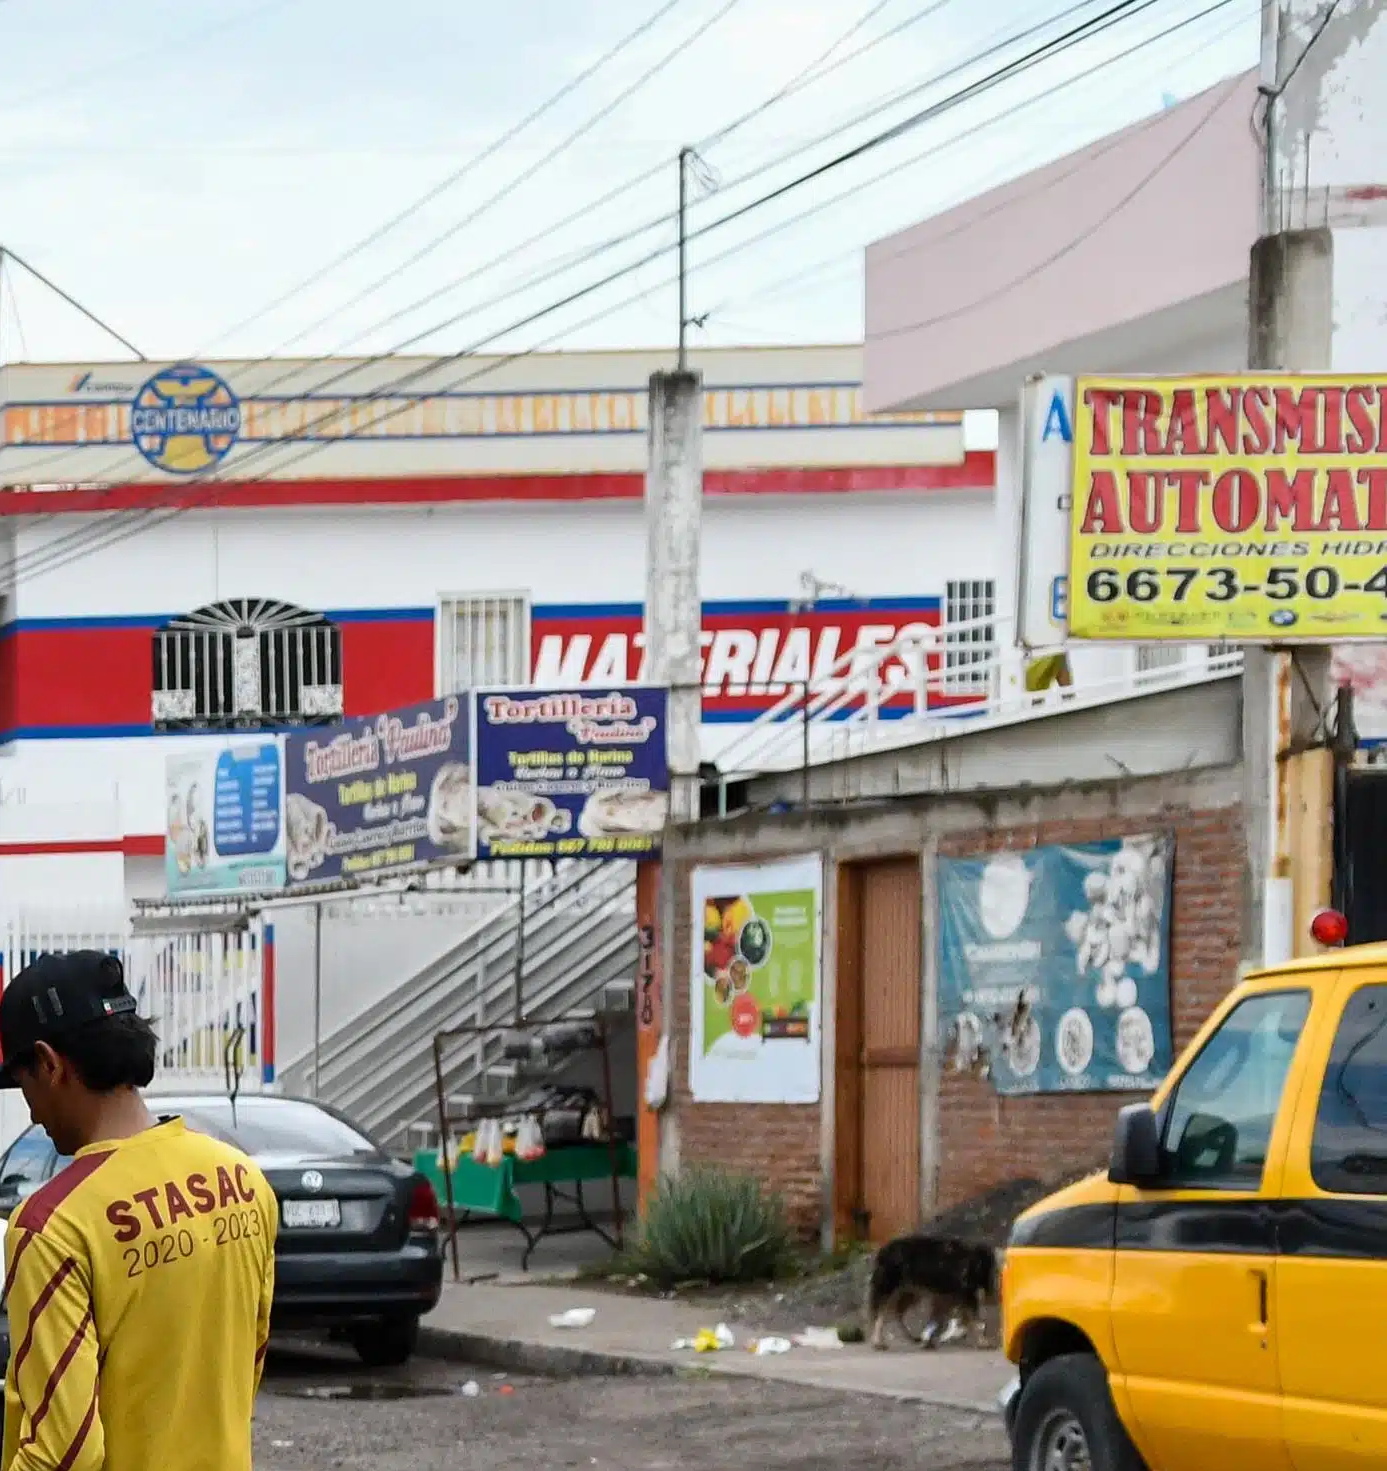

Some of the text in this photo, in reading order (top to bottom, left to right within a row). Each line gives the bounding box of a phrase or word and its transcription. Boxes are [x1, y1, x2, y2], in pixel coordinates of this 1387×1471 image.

[134, 408, 240, 433] CENTENARIO
[1089, 541, 1309, 559] DIRECCIONES
[532, 623, 939, 698] MARIALES
[106, 1163, 255, 1243] STASAC
[123, 1229, 194, 1278] 2020
[213, 1208, 261, 1246] 2023
